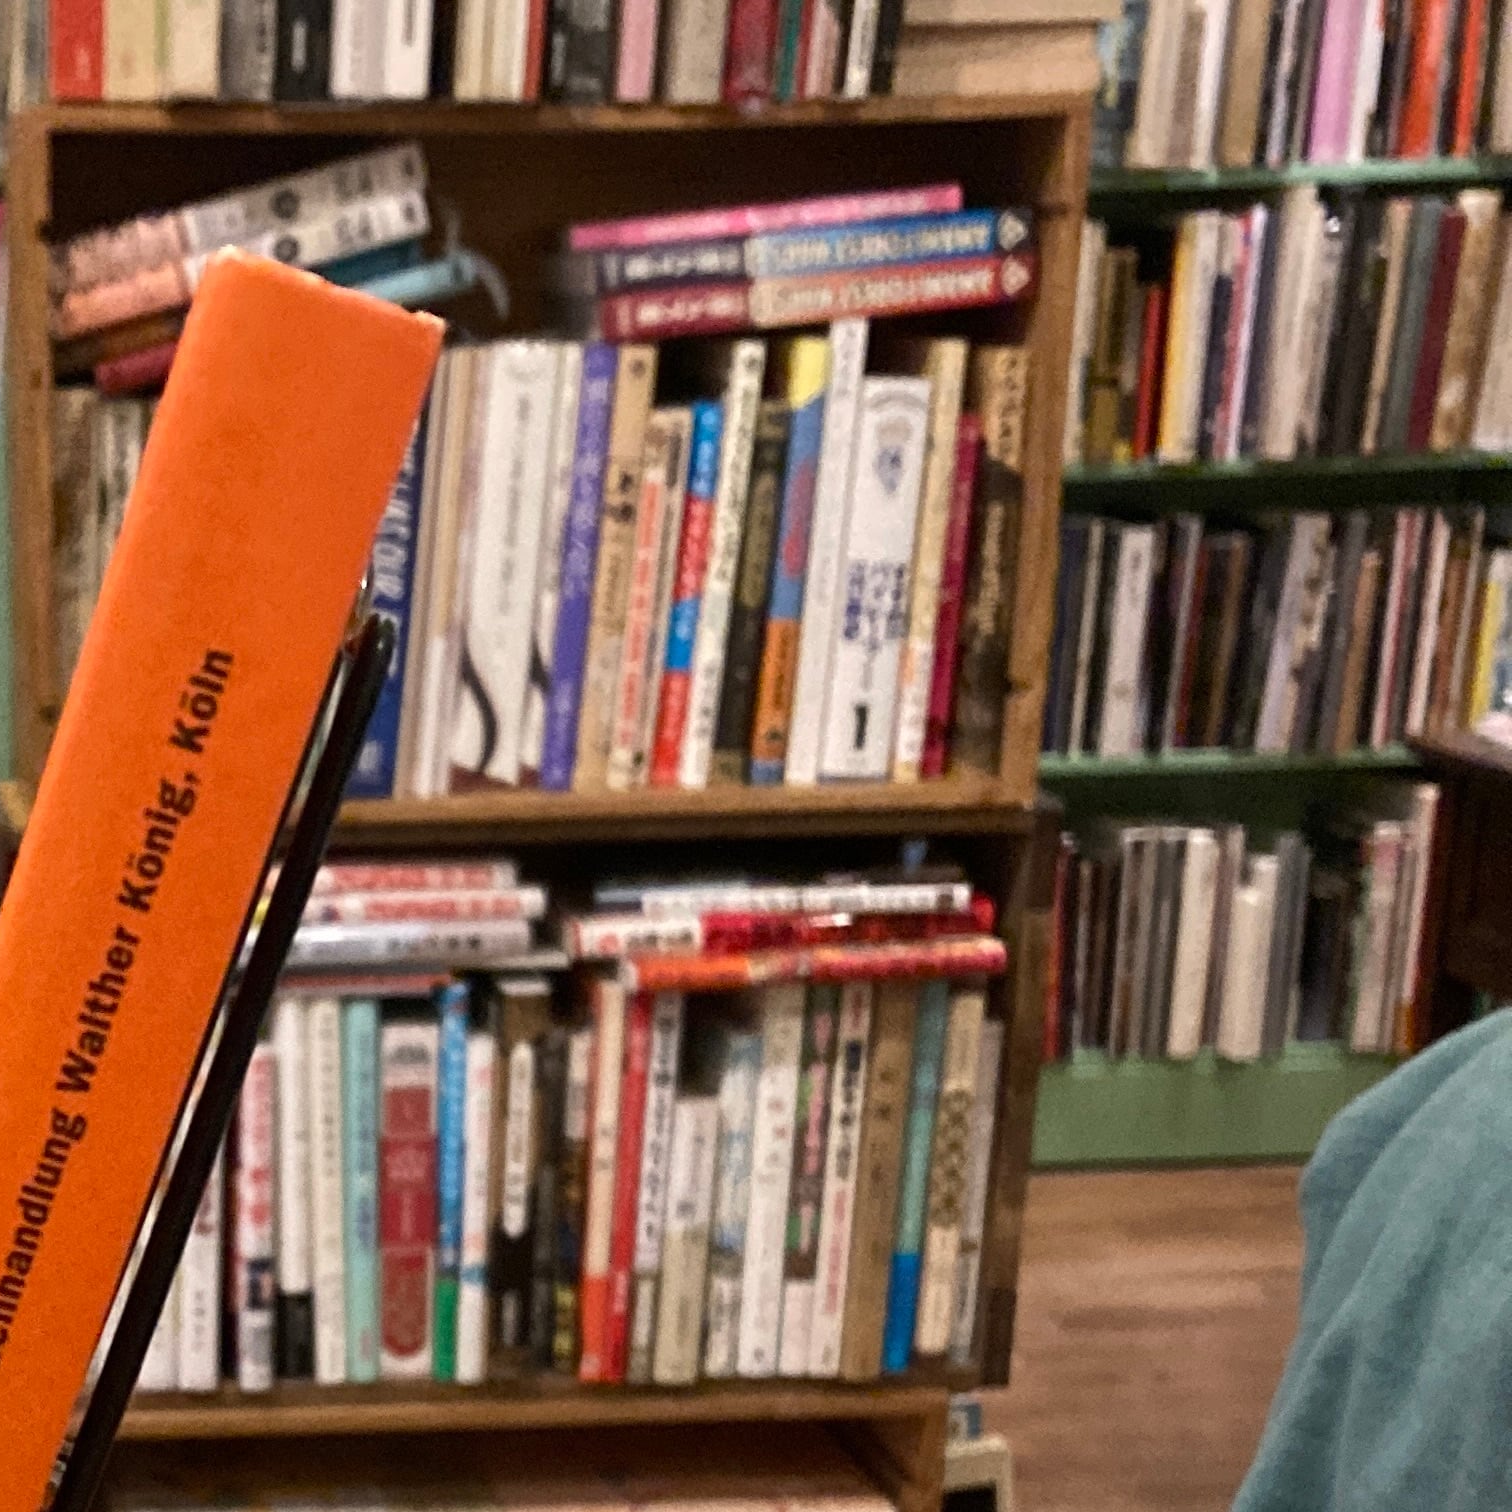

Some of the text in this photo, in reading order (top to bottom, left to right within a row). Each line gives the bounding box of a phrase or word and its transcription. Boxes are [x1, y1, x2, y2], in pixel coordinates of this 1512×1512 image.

[54, 924, 139, 1092] Walther
[115, 771, 199, 913] König,
[168, 649, 233, 754] Köln
